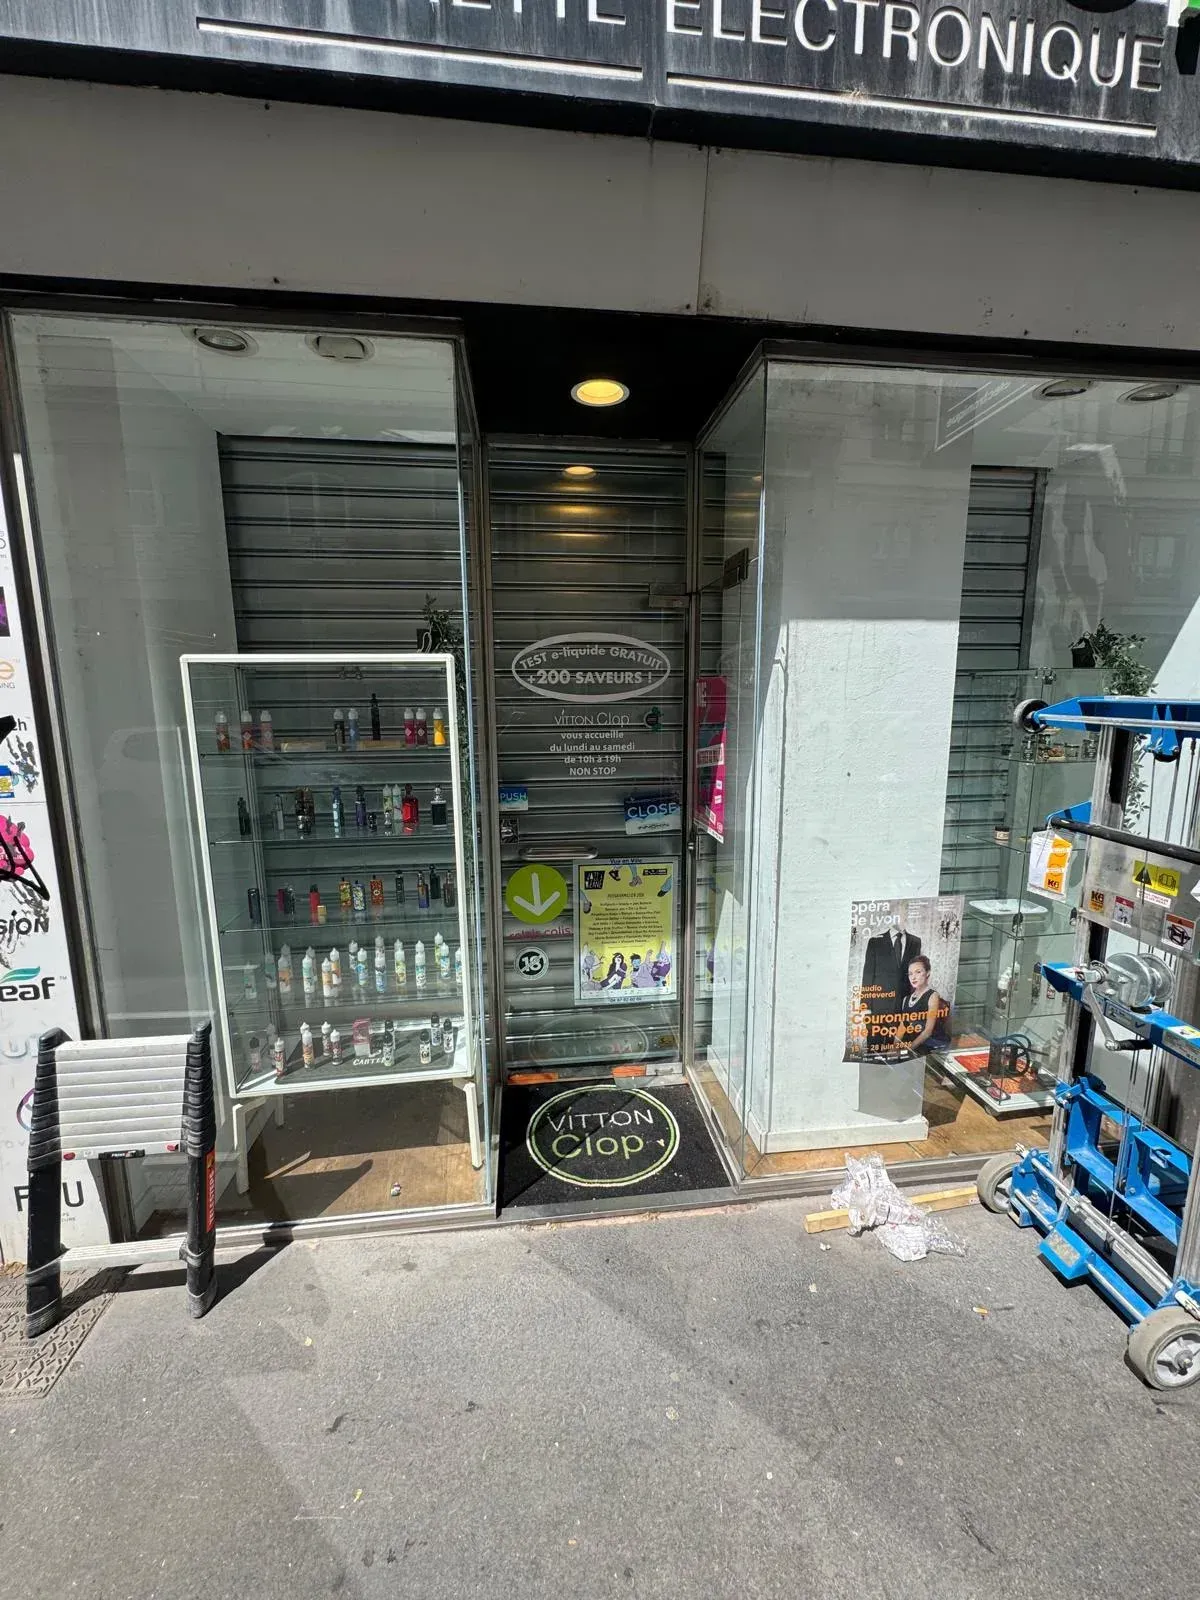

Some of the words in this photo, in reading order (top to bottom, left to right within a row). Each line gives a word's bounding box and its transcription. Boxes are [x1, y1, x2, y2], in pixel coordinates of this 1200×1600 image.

[667, 0, 1164, 93] ELECTRONIQUE
[519, 652, 548, 670] TEST
[551, 645, 606, 659] e-liquide
[575, 672, 642, 684] SAVEURS
[596, 712, 630, 728] Clop
[561, 732, 582, 740] vous
[584, 731, 624, 740] accueille
[550, 743, 562, 752] du
[563, 743, 588, 752] lundi
[589, 744, 601, 752] au
[603, 742, 635, 751] samedi
[564, 755, 576, 764] de
[577, 755, 595, 764] 10h
[605, 754, 621, 763] 19h
[569, 767, 591, 776] NON
[592, 766, 616, 776] STOP
[500, 792, 528, 801] PUSH
[627, 802, 677, 818] CLOSE
[851, 900, 890, 914] opéra
[851, 914, 867, 926] de
[869, 913, 901, 927] Lyon
[544, 926, 571, 937] colis
[852, 991, 896, 999] Monteverdi
[852, 1001, 868, 1012] Le
[851, 1006, 949, 1025] Couronnement
[851, 1026, 868, 1038] de
[872, 1023, 922, 1037] Poppée
[880, 1042, 894, 1050] juin
[552, 1133, 644, 1160] Clop
